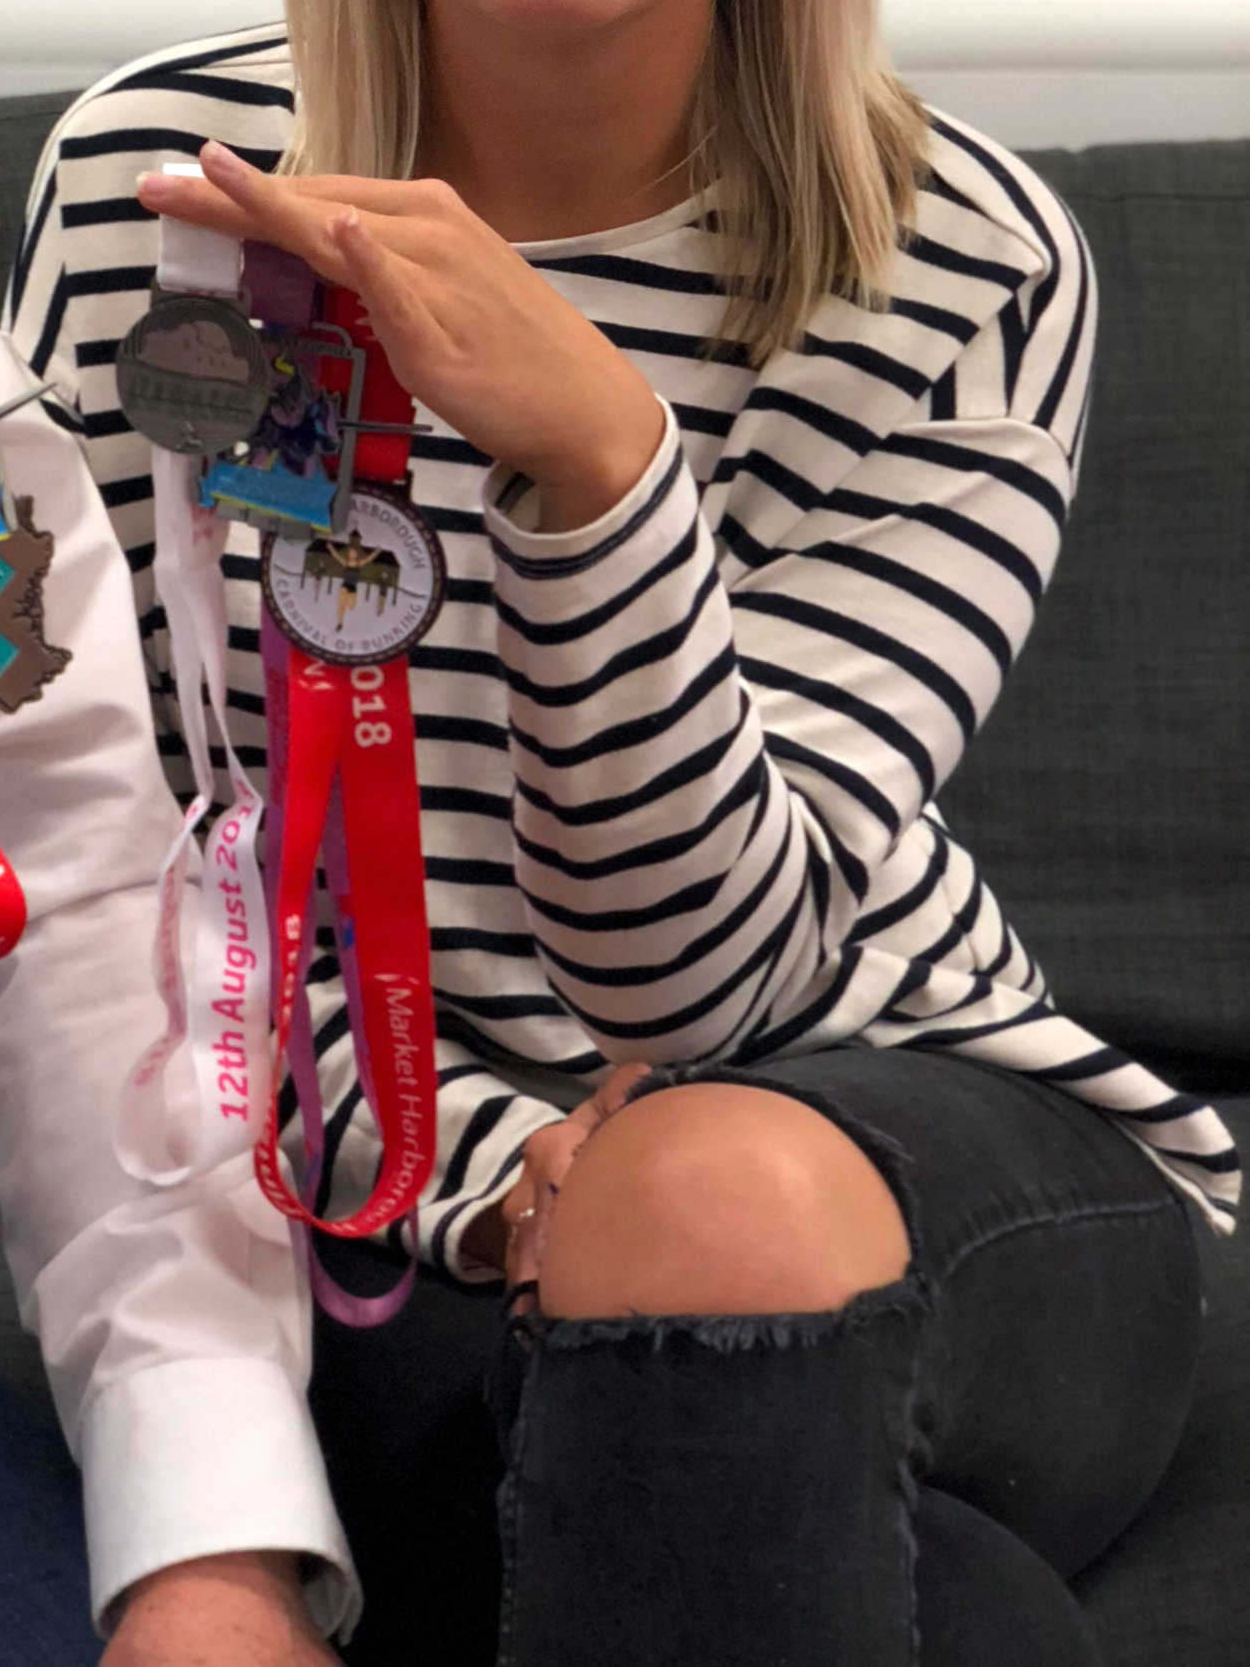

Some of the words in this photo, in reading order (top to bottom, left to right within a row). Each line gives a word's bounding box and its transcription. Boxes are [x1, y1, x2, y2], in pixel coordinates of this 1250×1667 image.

[350, 497, 428, 571] ARBOROUGH
[276, 577, 328, 645] CARNIVAL
[335, 637, 355, 652] OF
[362, 603, 424, 652] RUNNING
[350, 664, 393, 748] 018
[210, 881, 257, 1027] August
[212, 1033, 249, 1123] 12th
[384, 985, 416, 1088] Market
